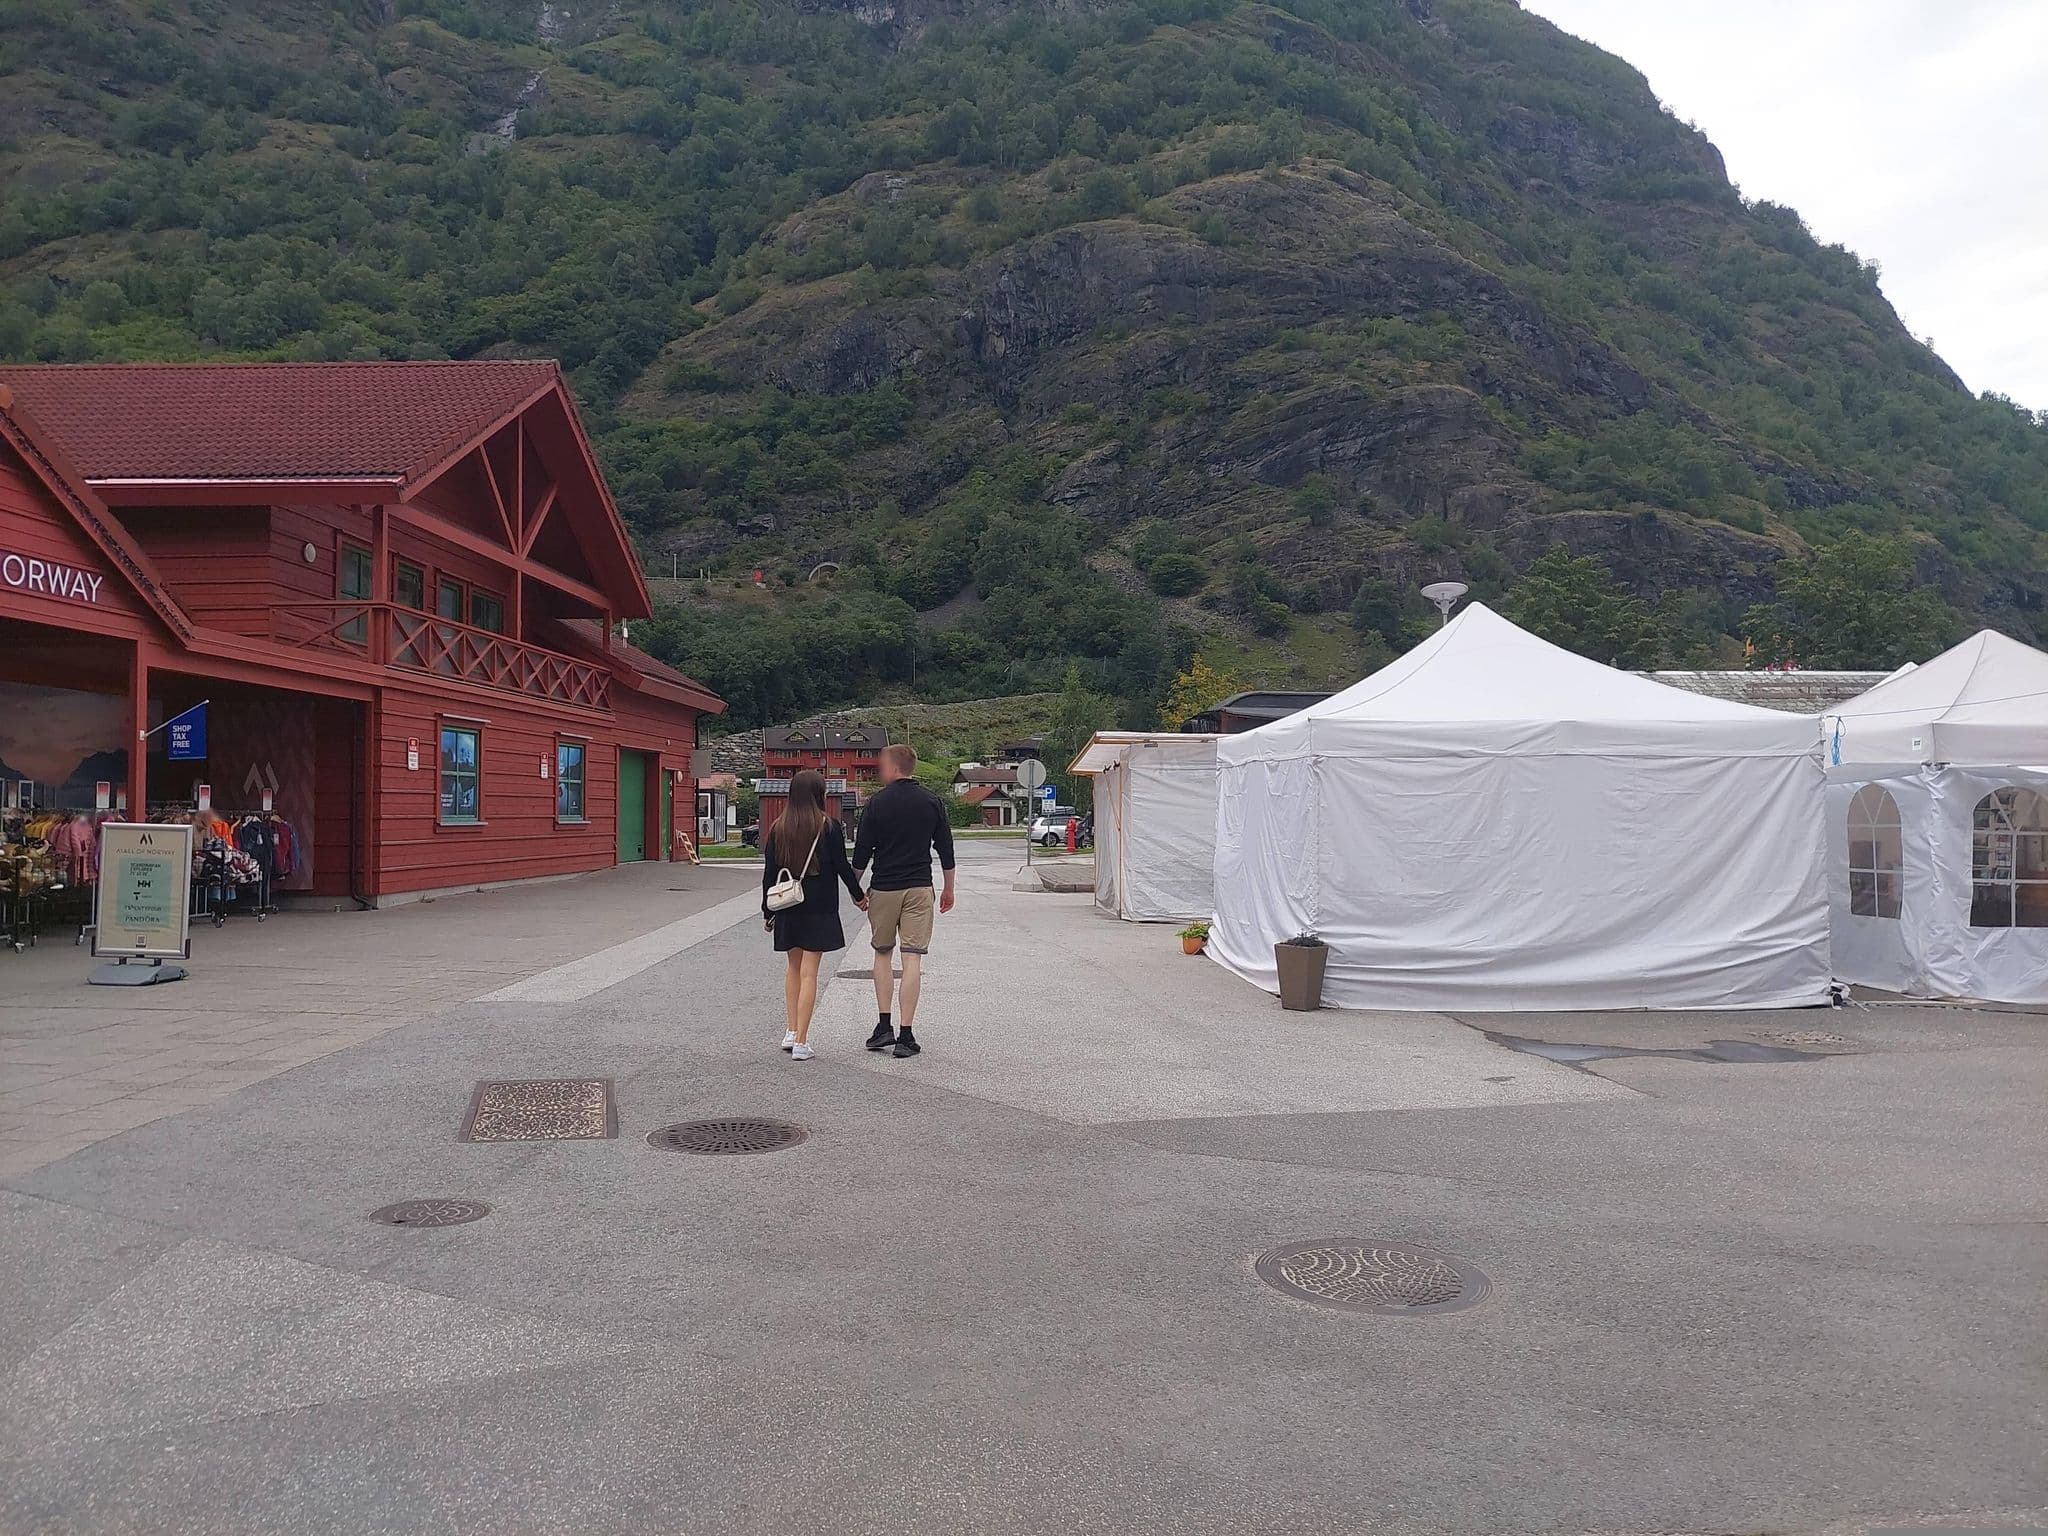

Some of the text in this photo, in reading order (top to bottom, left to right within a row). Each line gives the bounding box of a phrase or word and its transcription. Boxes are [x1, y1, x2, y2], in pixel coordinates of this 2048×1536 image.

[3, 554, 103, 603] ORWAY
[1045, 787, 1053, 798] P
[137, 880, 151, 888] HH
